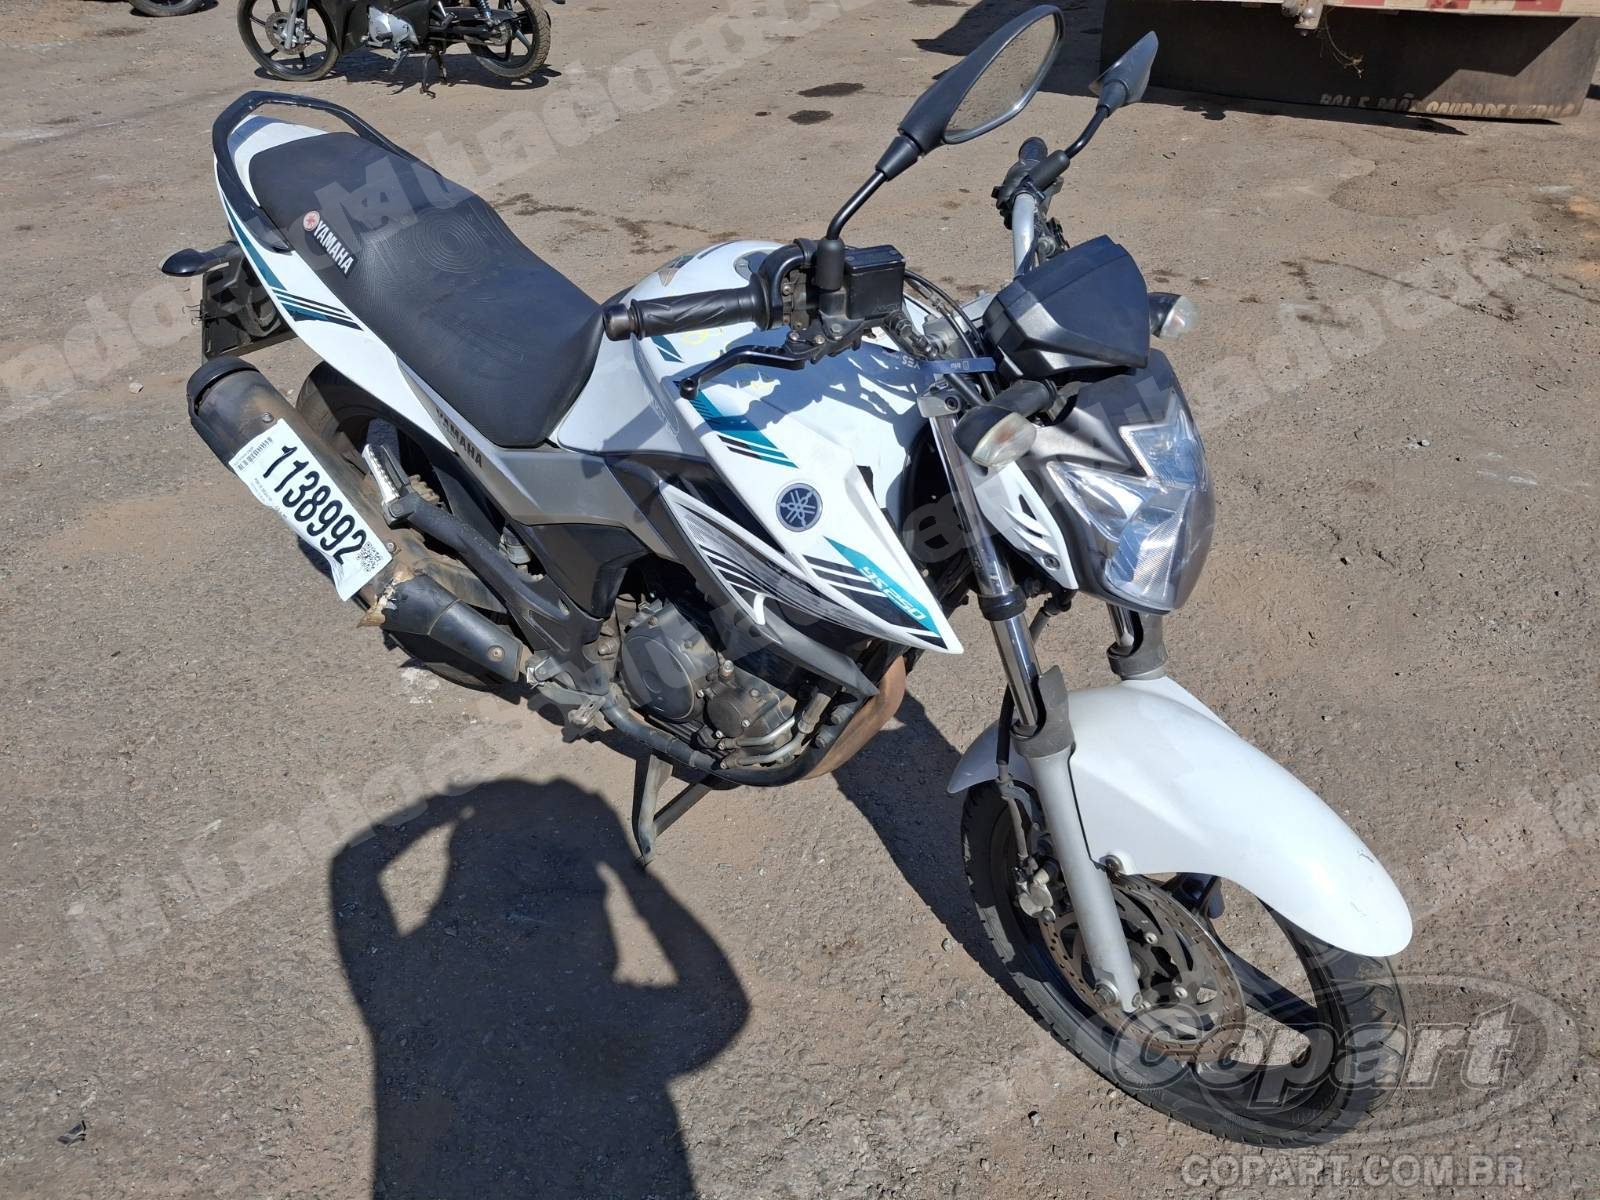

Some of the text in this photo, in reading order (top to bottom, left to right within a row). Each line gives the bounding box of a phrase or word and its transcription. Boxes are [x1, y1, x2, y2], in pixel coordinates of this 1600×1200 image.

[313, 219, 354, 275] YAMAHA
[435, 406, 483, 468] YAMAHA
[262, 445, 368, 566] 1138992
